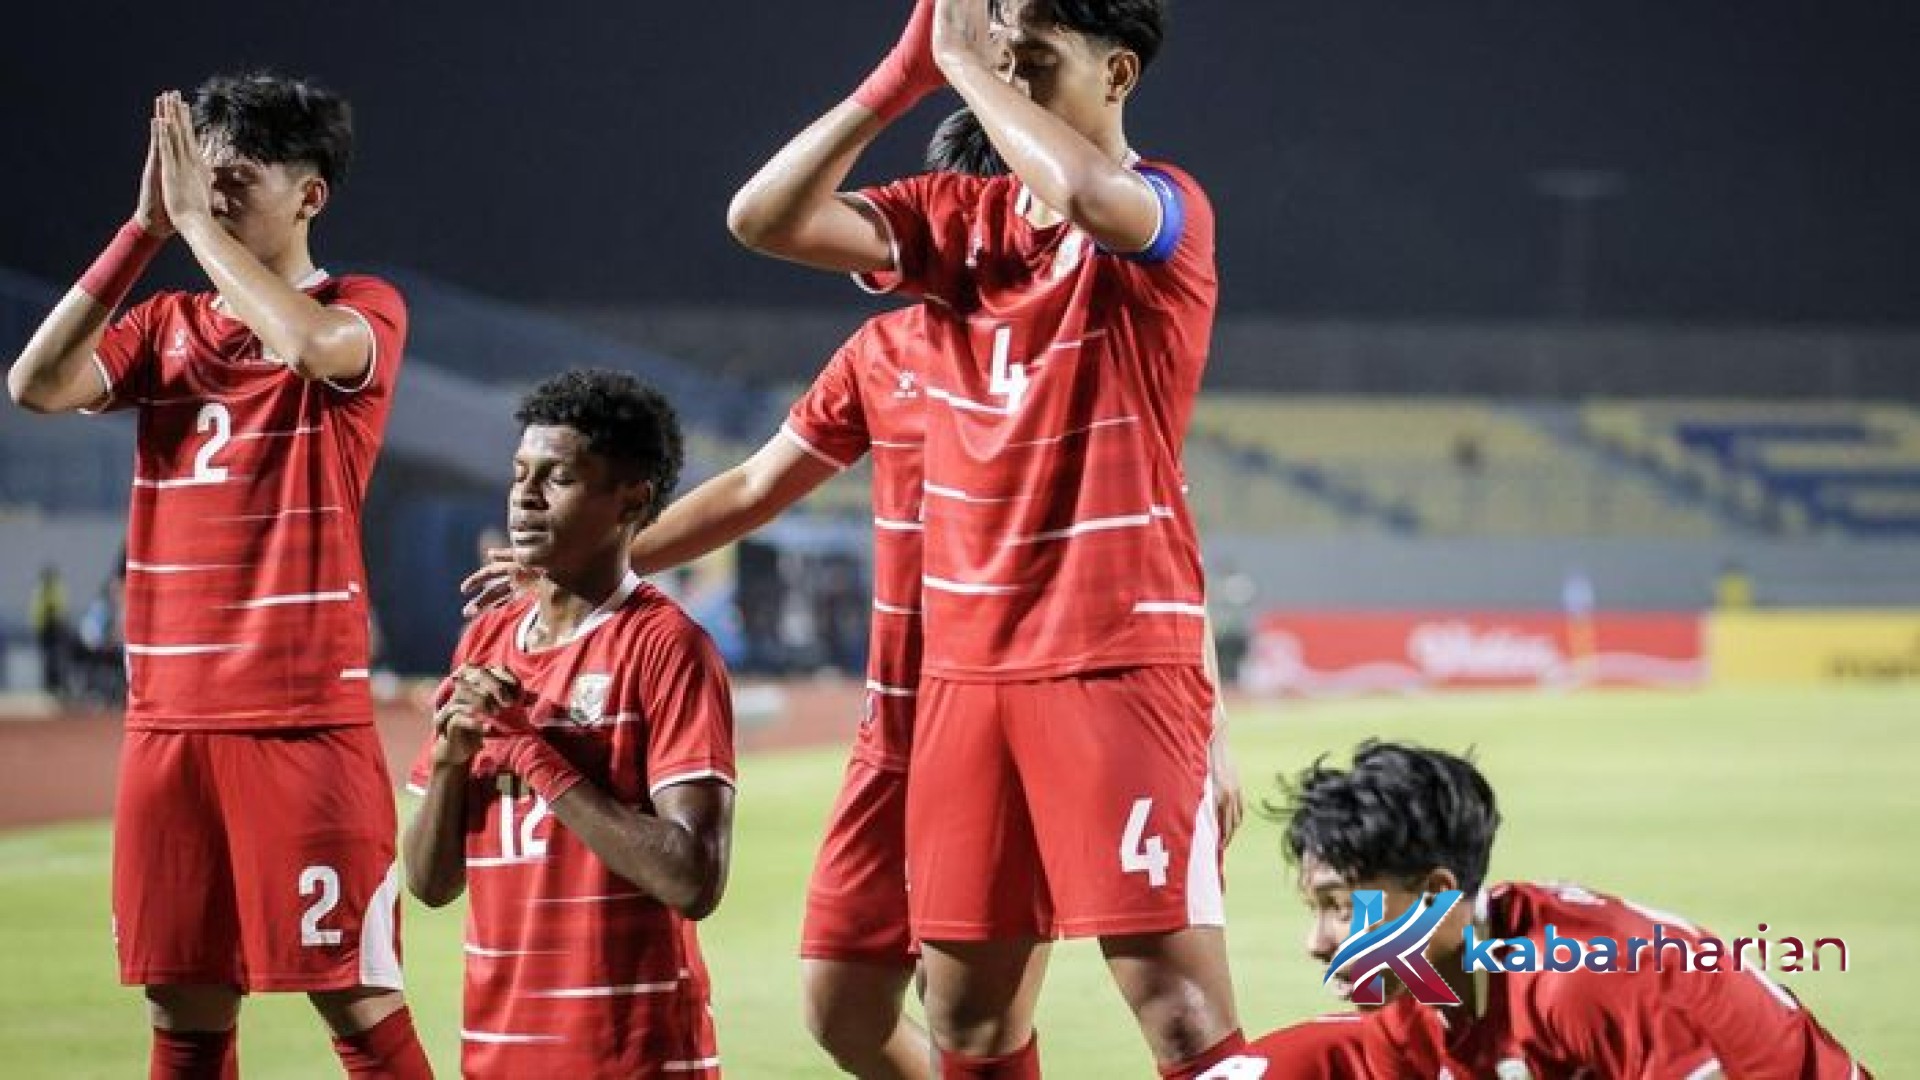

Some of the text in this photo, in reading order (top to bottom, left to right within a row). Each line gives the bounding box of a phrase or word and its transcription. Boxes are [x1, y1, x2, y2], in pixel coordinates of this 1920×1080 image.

[989, 327, 1029, 414] 4
[195, 402, 230, 483] 2
[1120, 798, 1169, 886] 4
[299, 865, 341, 946] 2
